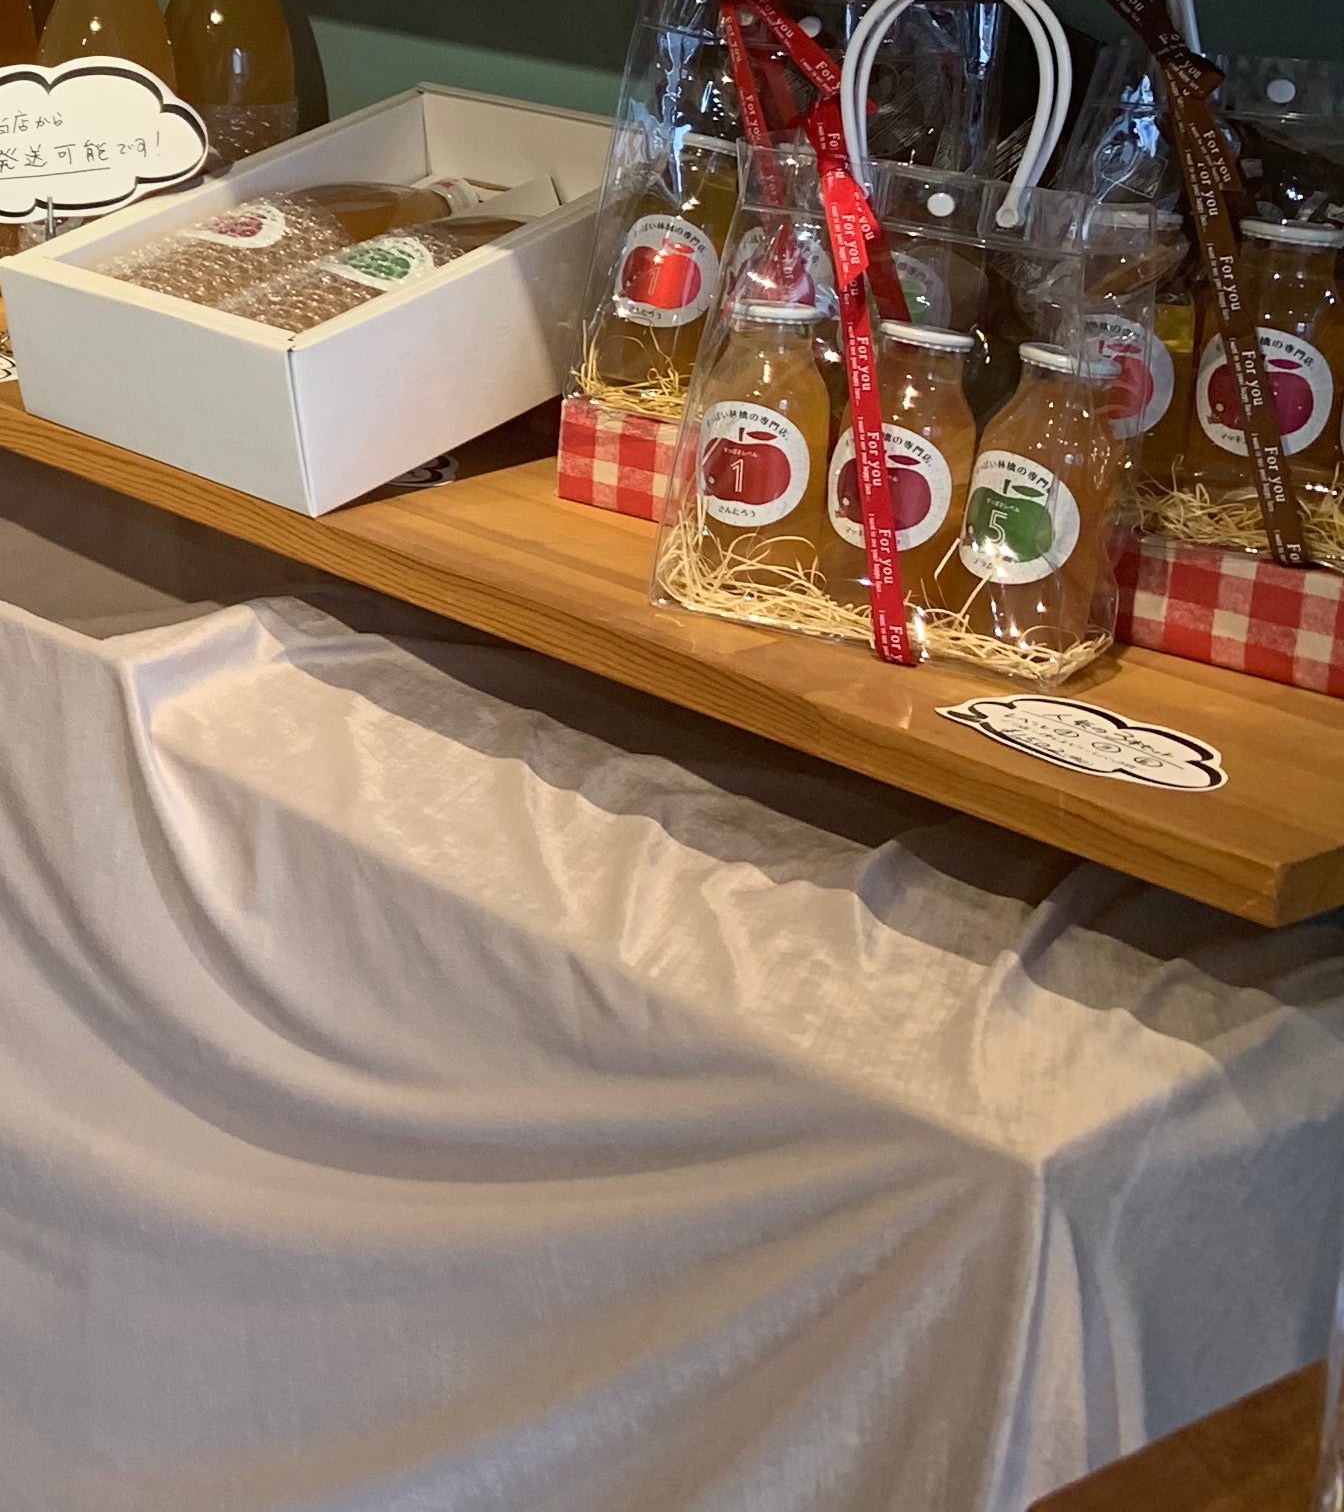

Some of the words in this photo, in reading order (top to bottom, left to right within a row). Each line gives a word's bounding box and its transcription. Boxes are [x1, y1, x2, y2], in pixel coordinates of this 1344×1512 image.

[773, 18, 794, 39] you
[815, 60, 836, 84] For
[1203, 128, 1221, 156] For
[1213, 163, 1232, 184] you
[1200, 189, 1219, 217] you
[841, 213, 858, 239] For
[847, 240, 862, 266] you
[1219, 254, 1234, 281] For
[1225, 290, 1241, 312] you
[856, 335, 870, 360] For
[1241, 349, 1257, 377] For
[858, 365, 871, 392] you
[1245, 383, 1264, 407] you
[867, 431, 880, 455] For
[1264, 444, 1279, 472] For
[729, 458, 745, 494] 1
[868, 460, 882, 488] you
[1268, 478, 1286, 504] you
[717, 506, 758, 518] さんたろう
[878, 528, 892, 553] For
[988, 509, 1009, 546] 5
[879, 558, 894, 585] you
[888, 625, 903, 648] For
